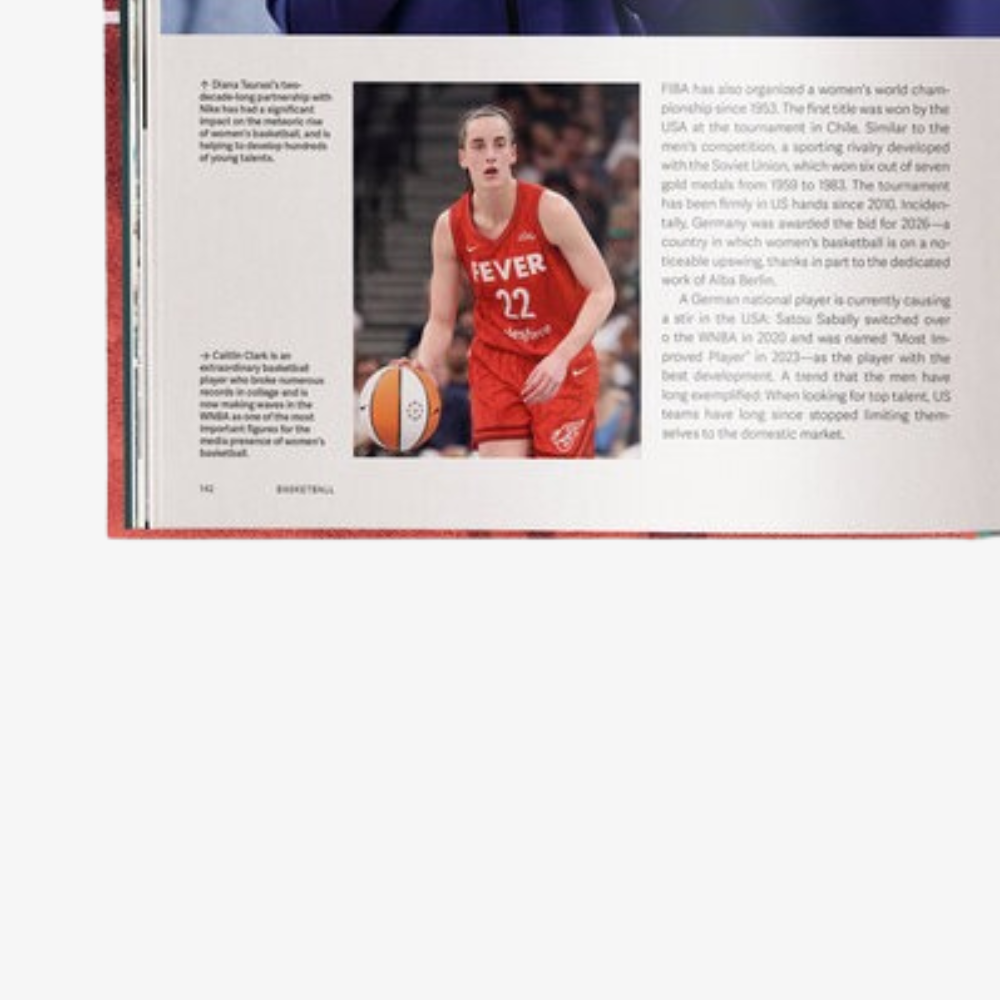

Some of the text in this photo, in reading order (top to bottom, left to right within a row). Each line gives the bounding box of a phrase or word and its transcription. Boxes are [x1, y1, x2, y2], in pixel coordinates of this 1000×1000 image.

[212, 80, 239, 89] Diana
[661, 83, 689, 95] FIBA
[692, 83, 714, 95] has
[717, 83, 742, 95] also
[745, 83, 805, 99] organized
[807, 87, 815, 95] a
[875, 84, 908, 95] world
[199, 92, 332, 104] decade-long partnership with
[199, 104, 220, 114] Nike
[221, 104, 239, 114] has
[240, 104, 258, 114] had
[267, 104, 315, 116] significant
[199, 128, 209, 138] of
[304, 128, 322, 138] and
[323, 128, 331, 138] is
[661, 121, 687, 133] USA
[692, 121, 705, 133] at
[709, 121, 730, 133] the
[734, 121, 806, 133] tournament
[809, 122, 823, 133] in
[865, 122, 907, 134] Similar
[912, 122, 925, 134] to
[929, 122, 950, 134] the
[781, 144, 789, 152] a
[792, 141, 843, 157] sporting
[847, 141, 883, 157] rivalry
[887, 141, 951, 157] developed
[199, 153, 209, 162] of
[210, 155, 239, 165] young
[661, 179, 687, 194] gold
[691, 179, 735, 191] medals
[737, 179, 767, 191] from
[771, 179, 798, 191] 1959
[801, 179, 815, 191] to
[852, 179, 875, 191] The
[878, 179, 950, 191] tournament
[691, 217, 747, 233] Germany
[750, 221, 775, 229] was
[778, 217, 830, 229] awarded
[832, 217, 854, 229] the
[857, 217, 877, 229] bid
[880, 218, 897, 229] for
[470, 252, 547, 283] FEVER
[661, 255, 709, 267] ticeable
[767, 255, 808, 267] thanks
[811, 256, 823, 267] in
[824, 256, 850, 271] part
[852, 256, 865, 267] to
[867, 256, 888, 268] the
[890, 256, 951, 268] dedicated
[661, 274, 690, 286] work
[693, 274, 706, 286] of
[709, 274, 736, 286] Alba
[495, 286, 537, 320] 22
[212, 350, 242, 360] Caitlin
[243, 350, 269, 360] Clark
[270, 350, 279, 360] is
[200, 363, 310, 375] extraordinary basketball
[199, 375, 228, 387] player
[230, 375, 249, 384] who
[250, 375, 277, 384] broke
[200, 423, 311, 435] important figures for the
[662, 427, 700, 439] selves
[702, 427, 715, 439] to
[717, 427, 738, 439] the
[741, 428, 797, 439] domestic
[200, 435, 228, 445] media
[230, 438, 271, 447] presence
[273, 435, 284, 445] of
[276, 484, 334, 493] BASKETBALL
